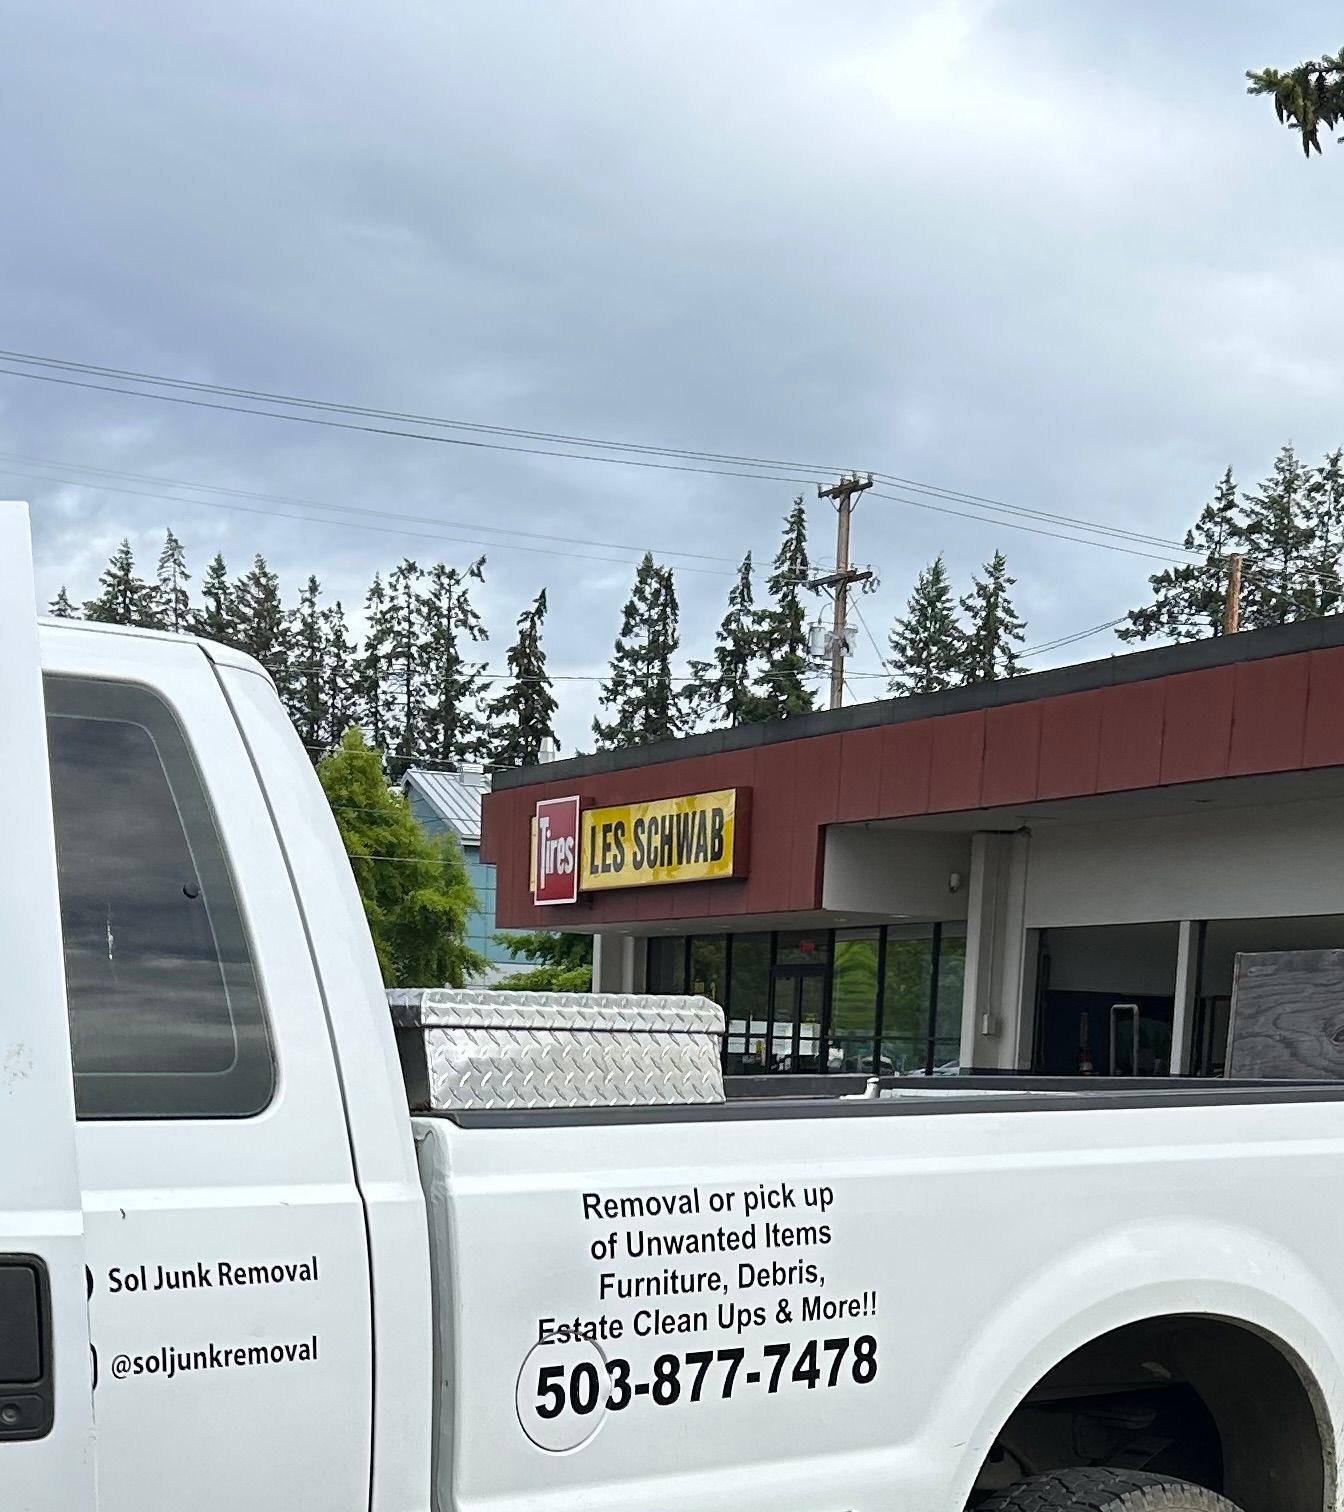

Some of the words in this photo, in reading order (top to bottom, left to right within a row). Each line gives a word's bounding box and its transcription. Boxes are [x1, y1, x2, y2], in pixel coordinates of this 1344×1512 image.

[539, 816, 575, 890] Tires
[589, 820, 626, 876] LES
[632, 806, 725, 871] SCHWAB
[582, 1187, 700, 1220] Removal
[709, 1192, 736, 1212] or
[744, 1183, 796, 1217] pick
[804, 1186, 834, 1212] up
[591, 1232, 618, 1260] of
[626, 1223, 756, 1258] Unwanted
[765, 1222, 832, 1248] Items
[108, 1265, 147, 1293] Sol
[154, 1262, 213, 1291] Junk
[218, 1256, 319, 1286] Removal
[599, 1268, 728, 1300] Furniture,
[738, 1259, 825, 1289] Debris,
[538, 1314, 624, 1346] Estate
[633, 1309, 708, 1337] Clean
[718, 1302, 766, 1335] Ups
[775, 1298, 793, 1324] &
[802, 1291, 877, 1322] More!!
[111, 1335, 318, 1380] @soljunkremoval
[534, 1334, 878, 1420] 503-877-7478
